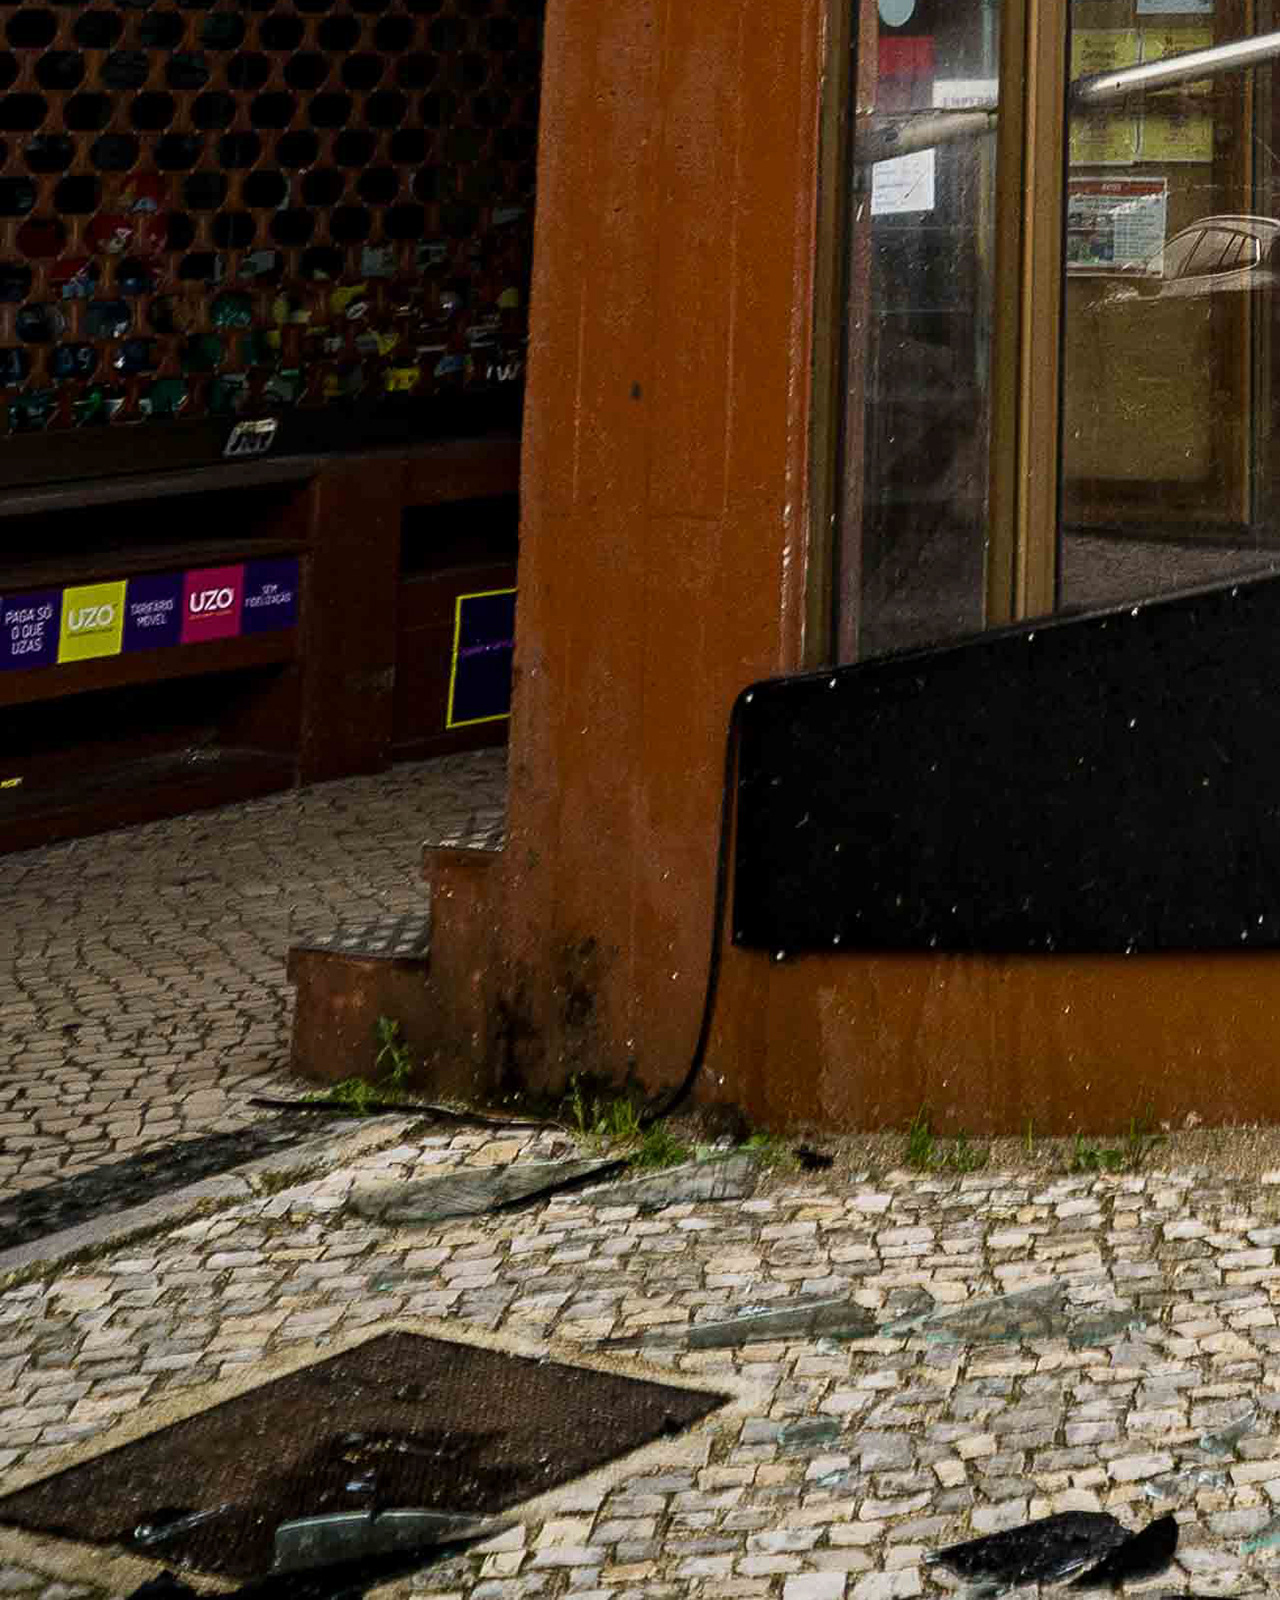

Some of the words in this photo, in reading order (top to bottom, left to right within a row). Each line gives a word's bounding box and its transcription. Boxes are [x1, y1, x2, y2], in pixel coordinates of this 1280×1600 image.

[189, 587, 235, 613] UZO
[5, 608, 36, 625] PAGA
[66, 603, 115, 632] UZO
[11, 625, 20, 640] O
[21, 621, 45, 639] QUE
[11, 638, 43, 655] UZAS
